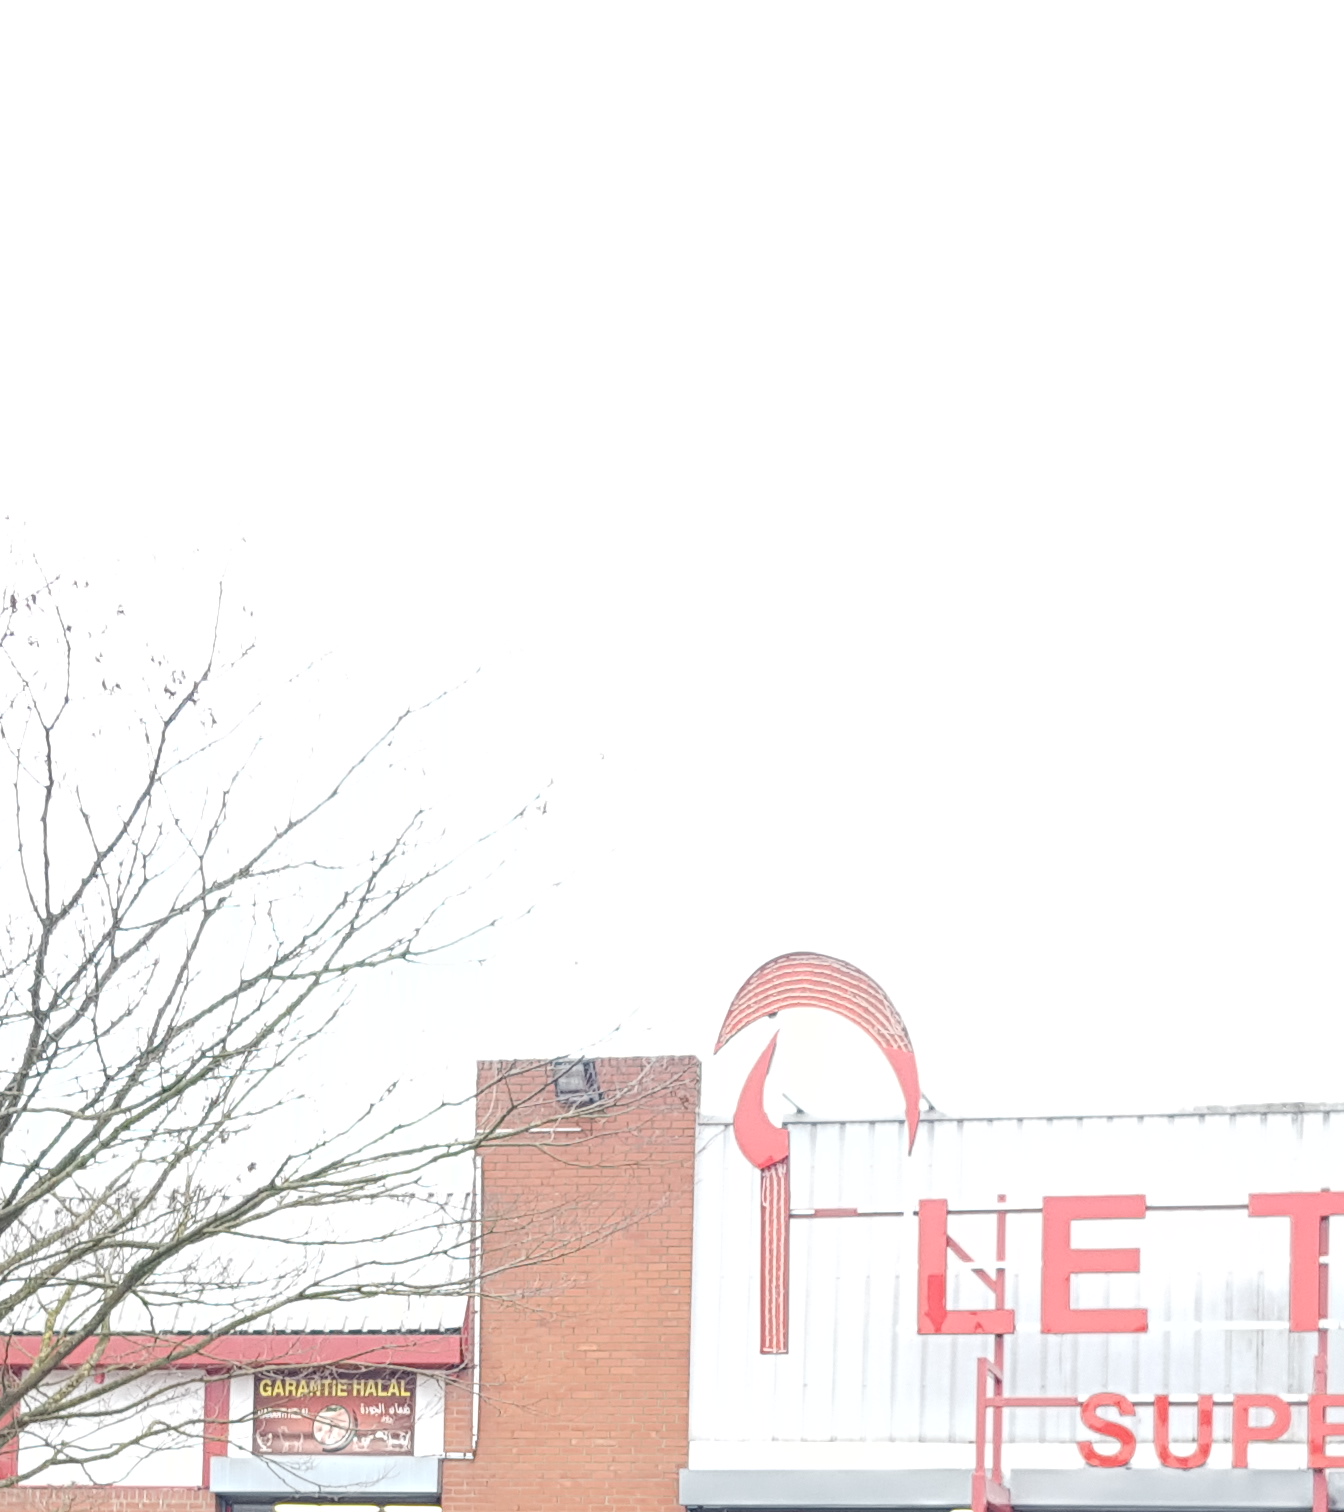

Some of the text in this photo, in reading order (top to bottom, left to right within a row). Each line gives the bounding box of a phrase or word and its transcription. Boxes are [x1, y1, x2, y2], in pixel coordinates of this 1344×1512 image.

[917, 1193, 1149, 1335] LE
[259, 1379, 411, 1397] GARANTIE HALAL
